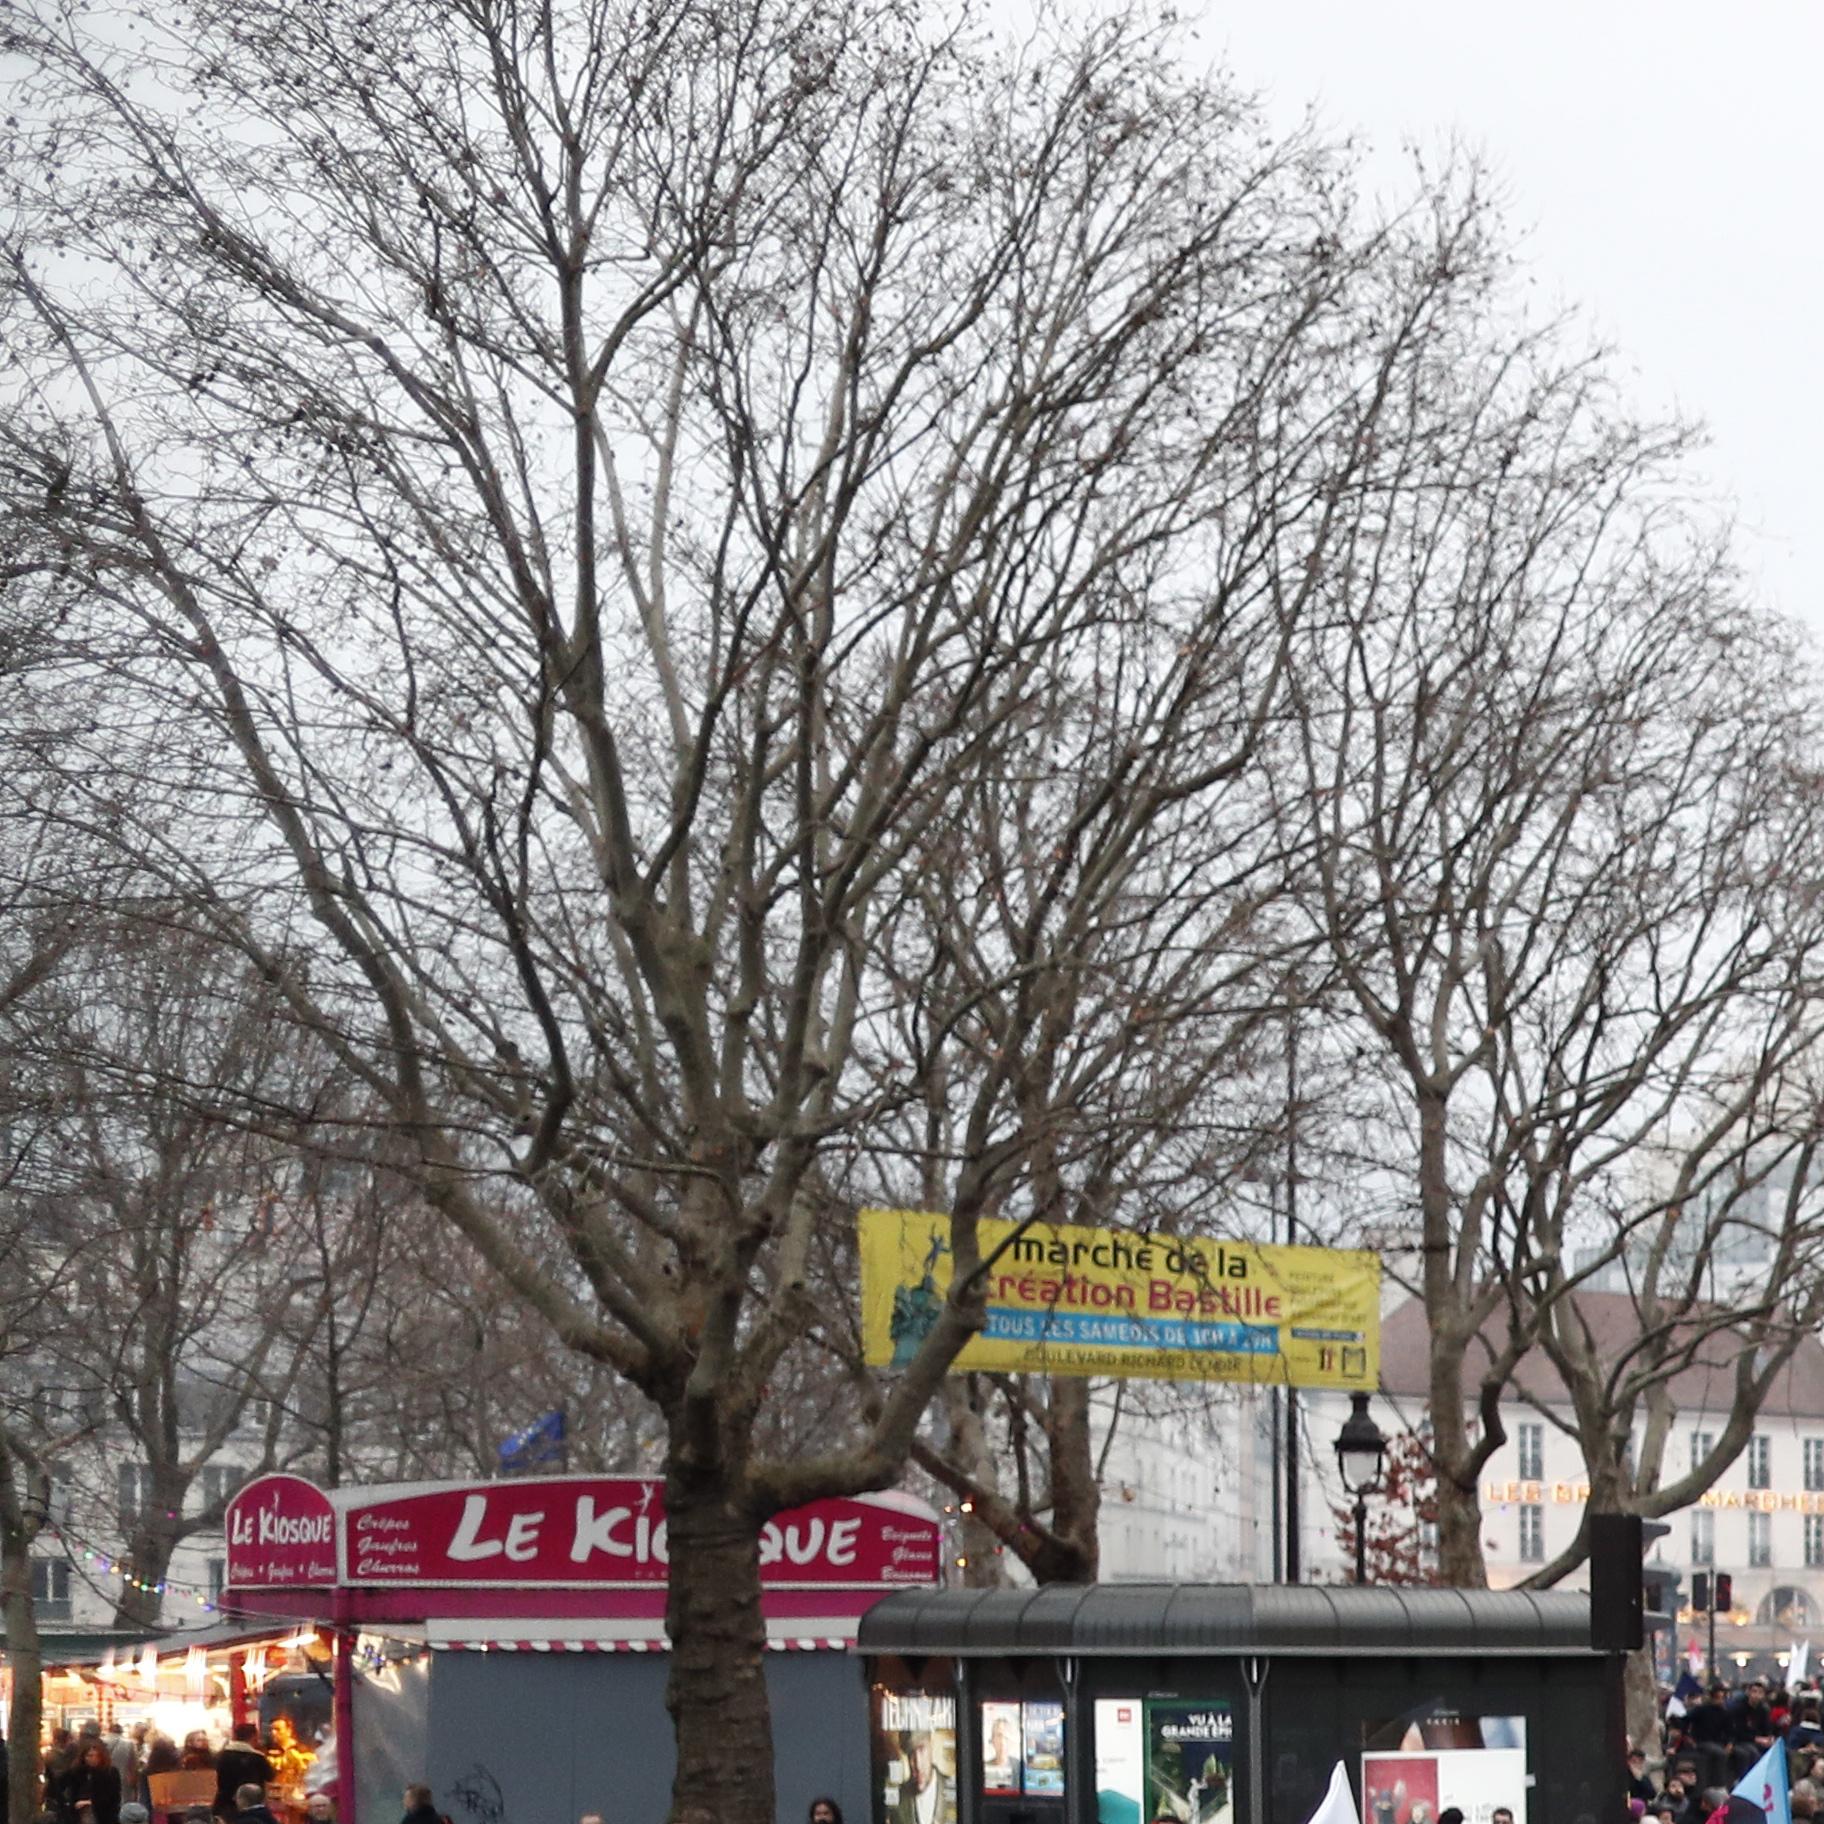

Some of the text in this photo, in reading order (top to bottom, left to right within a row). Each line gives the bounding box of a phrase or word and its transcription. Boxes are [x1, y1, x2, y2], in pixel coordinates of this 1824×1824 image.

[1218, 1247, 1248, 1279] la
[1149, 1279, 1282, 1318] Bastille
[990, 1314, 1035, 1336] TOUS
[1164, 1327, 1186, 1346] DE
[1485, 1482, 1542, 1503] LES
[231, 1507, 254, 1545] LE
[445, 1494, 545, 1562] LE
